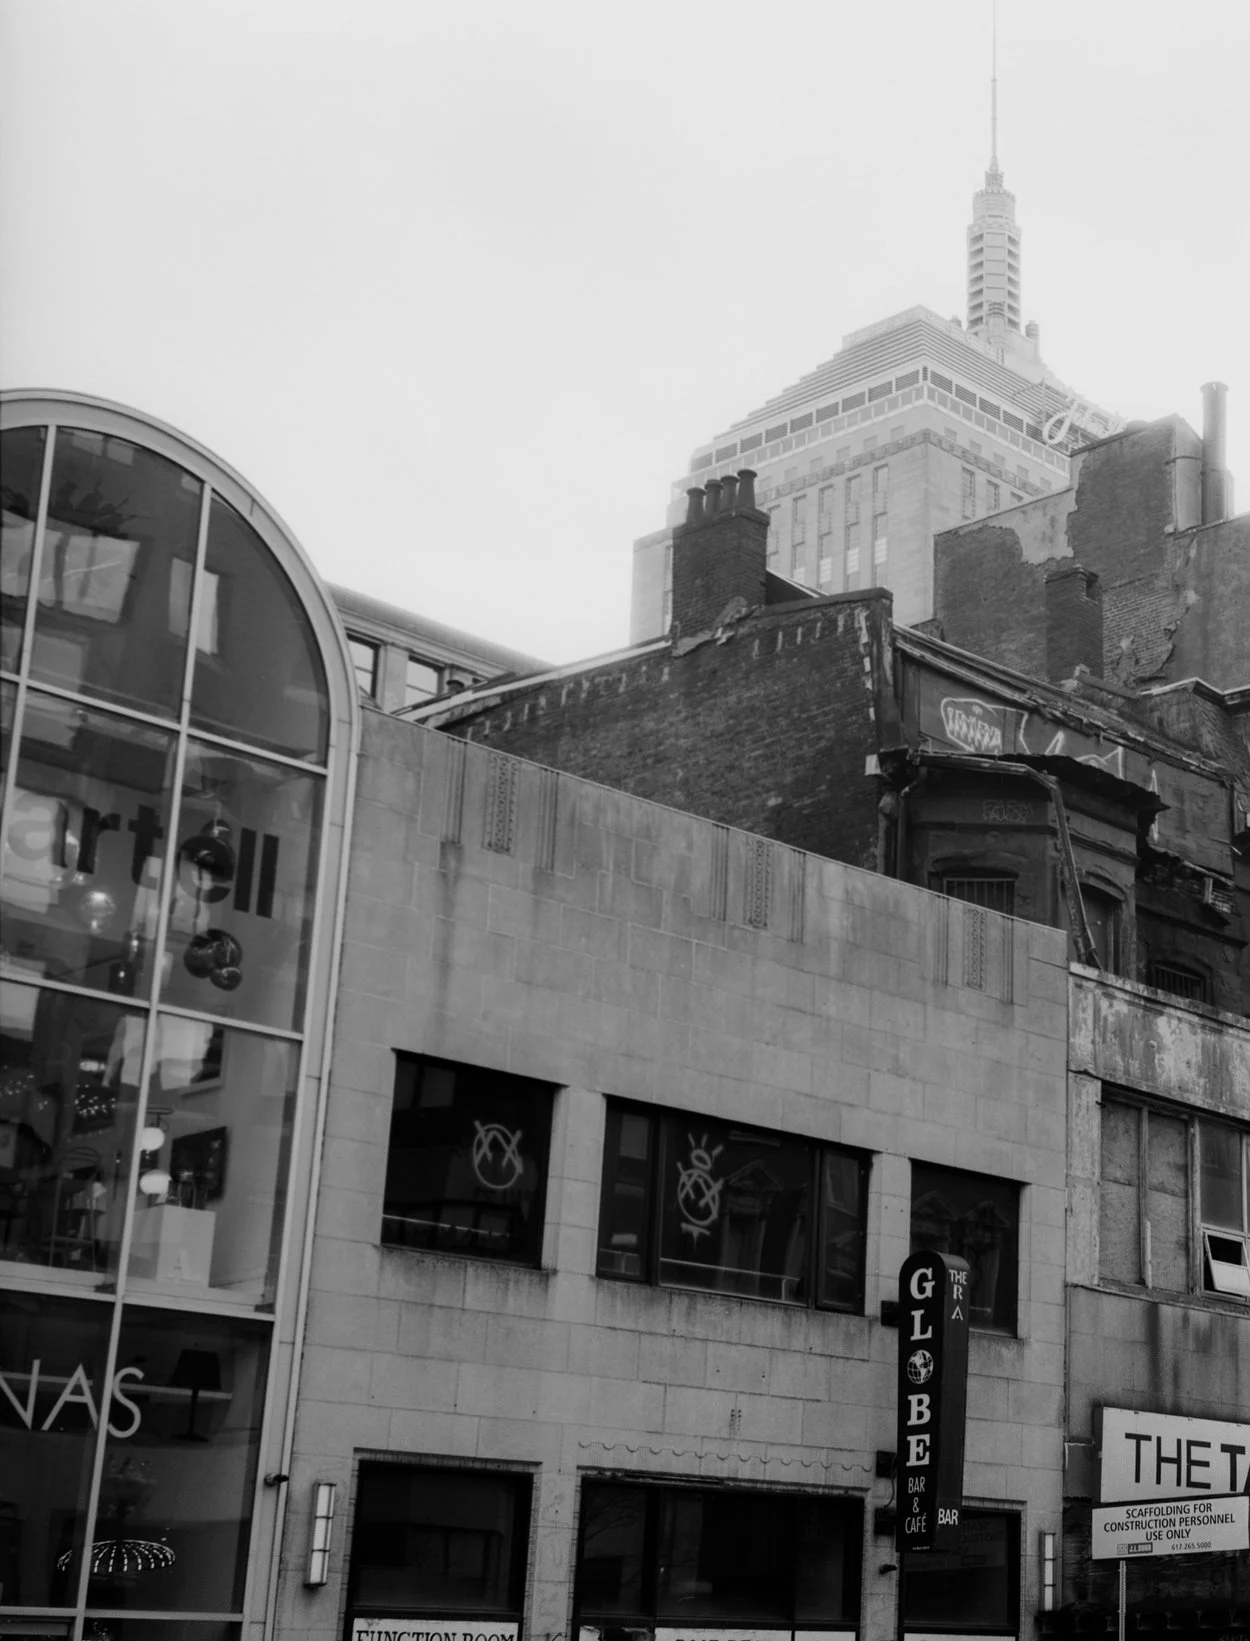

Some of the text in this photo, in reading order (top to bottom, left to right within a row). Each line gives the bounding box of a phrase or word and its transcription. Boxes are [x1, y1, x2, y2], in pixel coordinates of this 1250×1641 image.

[949, 1268, 967, 1286] THE
[1124, 1432, 1211, 1490] THE
[907, 1476, 926, 1494] BAR
[912, 1497, 920, 1513] &
[1125, 1502, 1213, 1519] SCAFFOLDING FOR
[905, 1513, 928, 1534] CAFÉ
[938, 1508, 958, 1526] BAR
[1103, 1513, 1236, 1533] CONSTRUCTION PERSONNEL
[1145, 1528, 1192, 1542] USE ONLY
